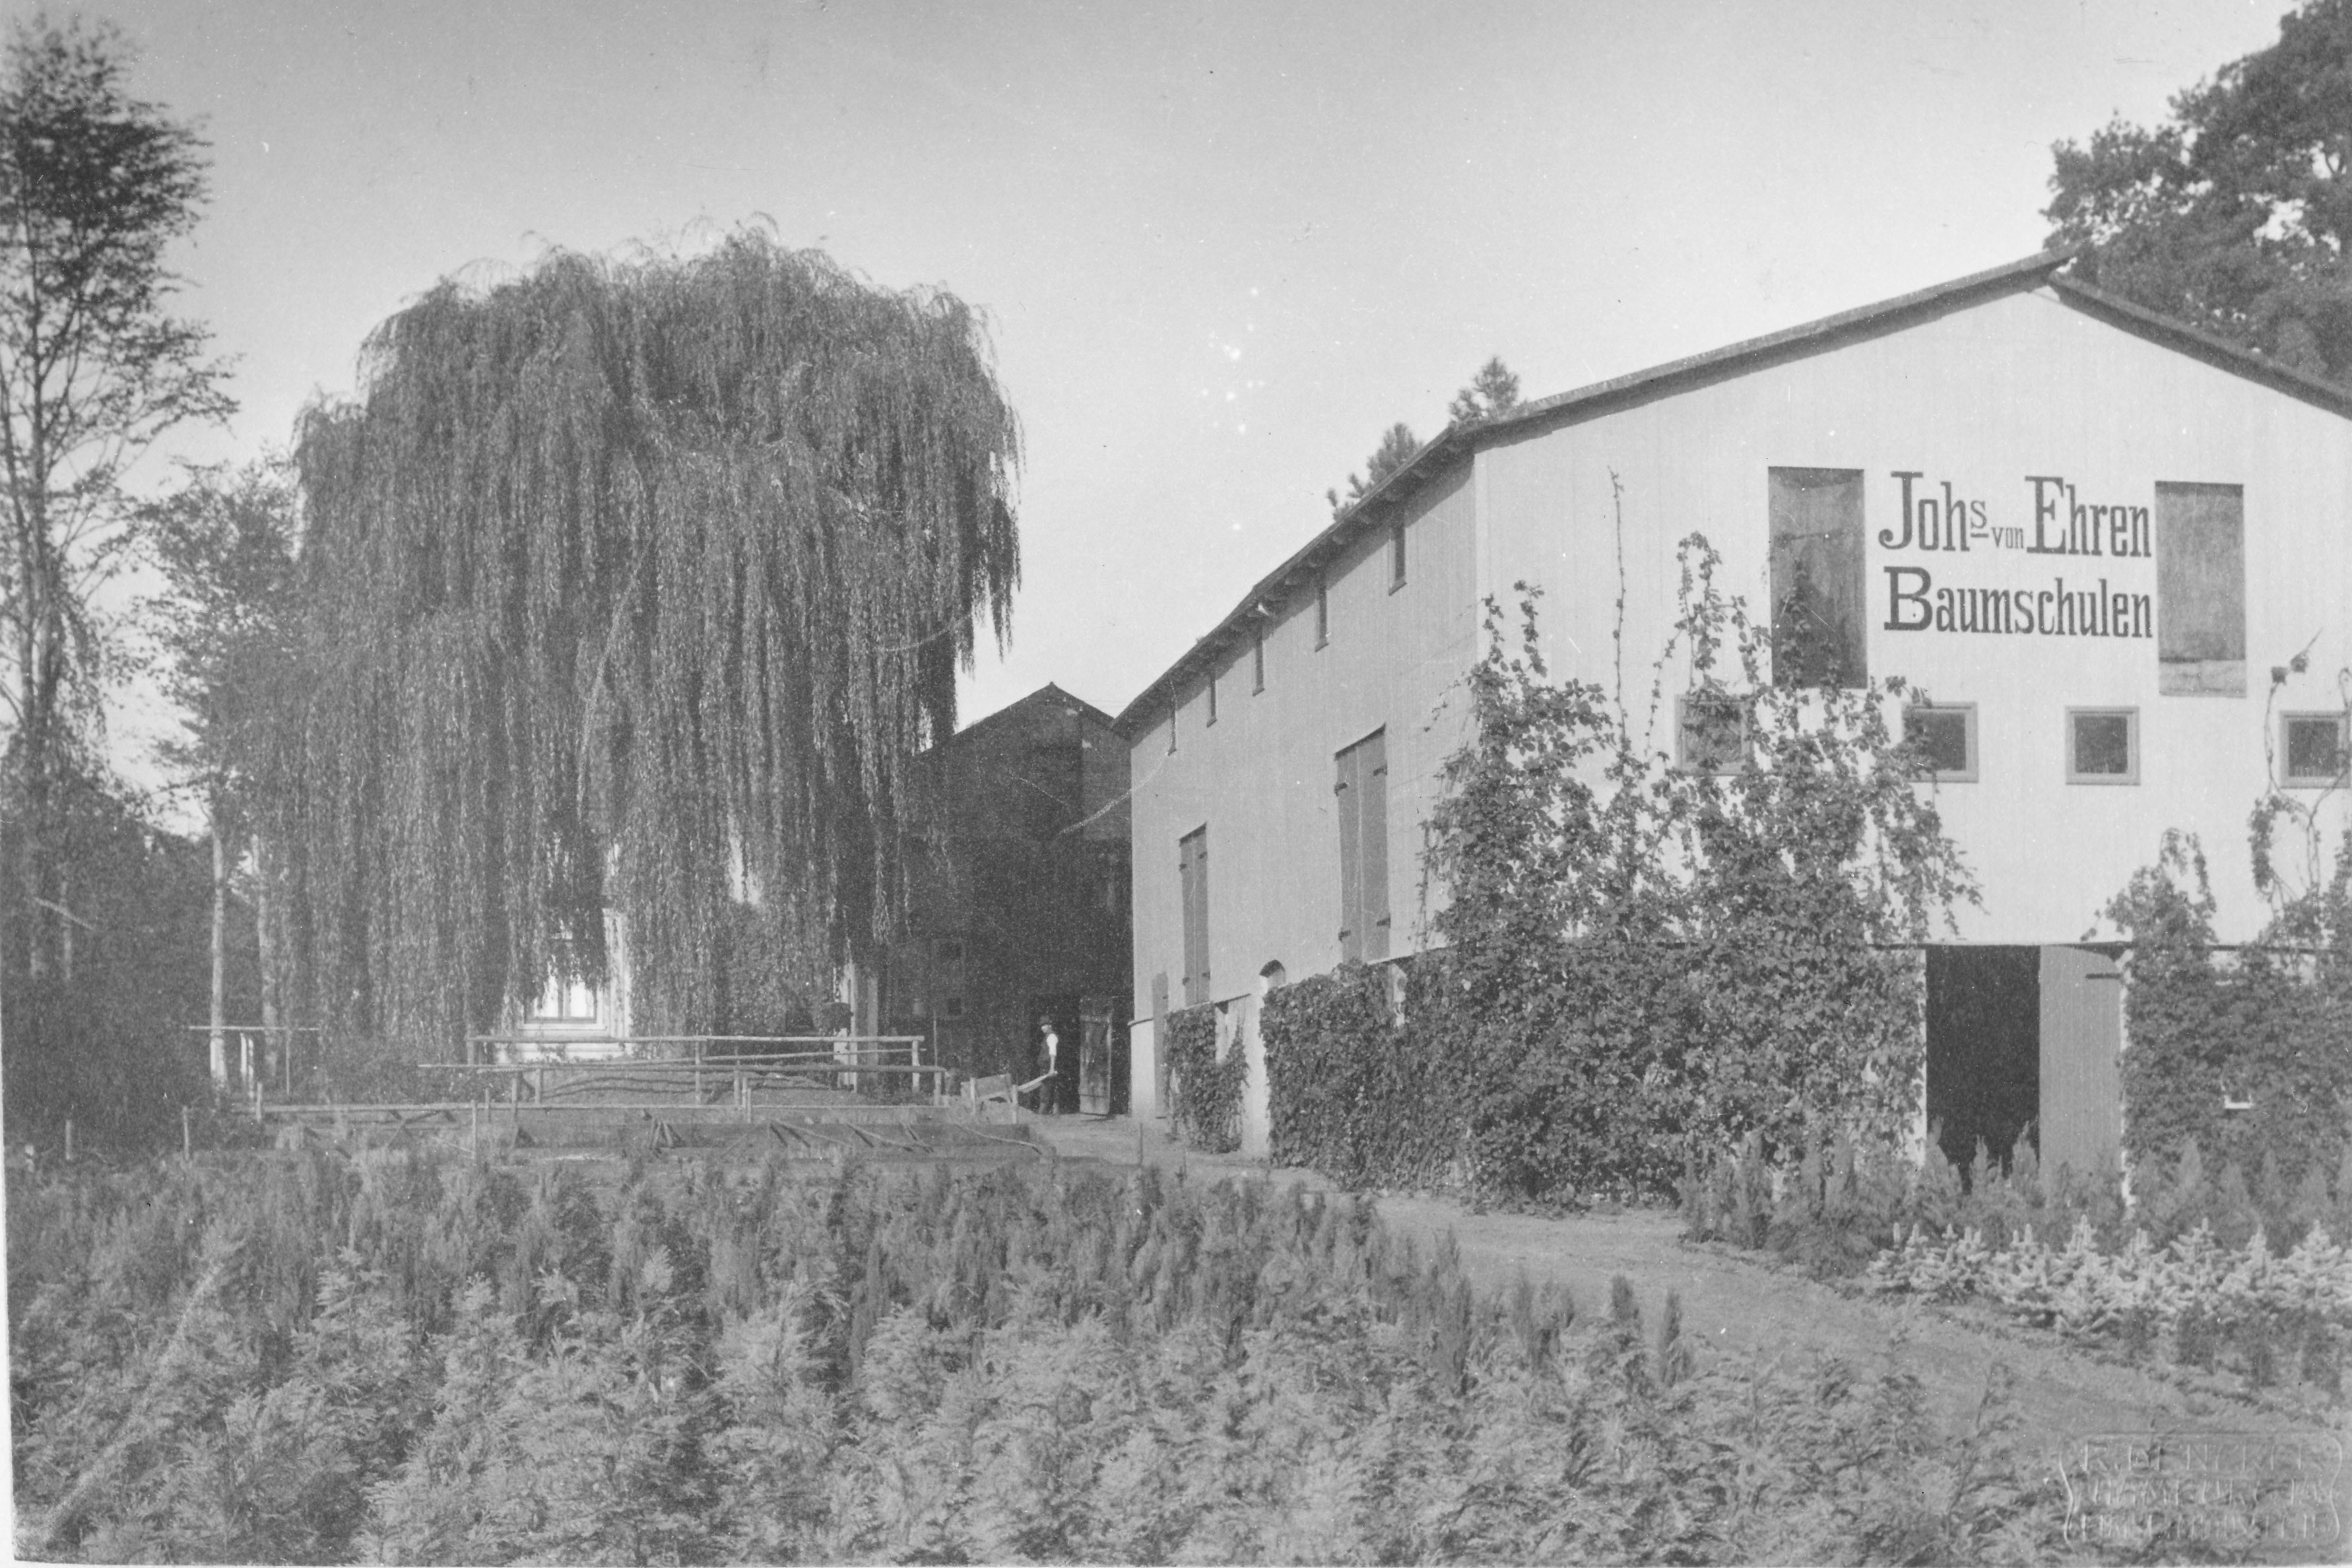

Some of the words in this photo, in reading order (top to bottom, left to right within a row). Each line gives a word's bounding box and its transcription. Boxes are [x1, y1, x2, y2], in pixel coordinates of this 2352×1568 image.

[1878, 471, 1988, 552] Johs
[1990, 526, 2025, 550] von
[2024, 476, 2151, 558] Ehren
[1883, 566, 2153, 639] Baumschulen
